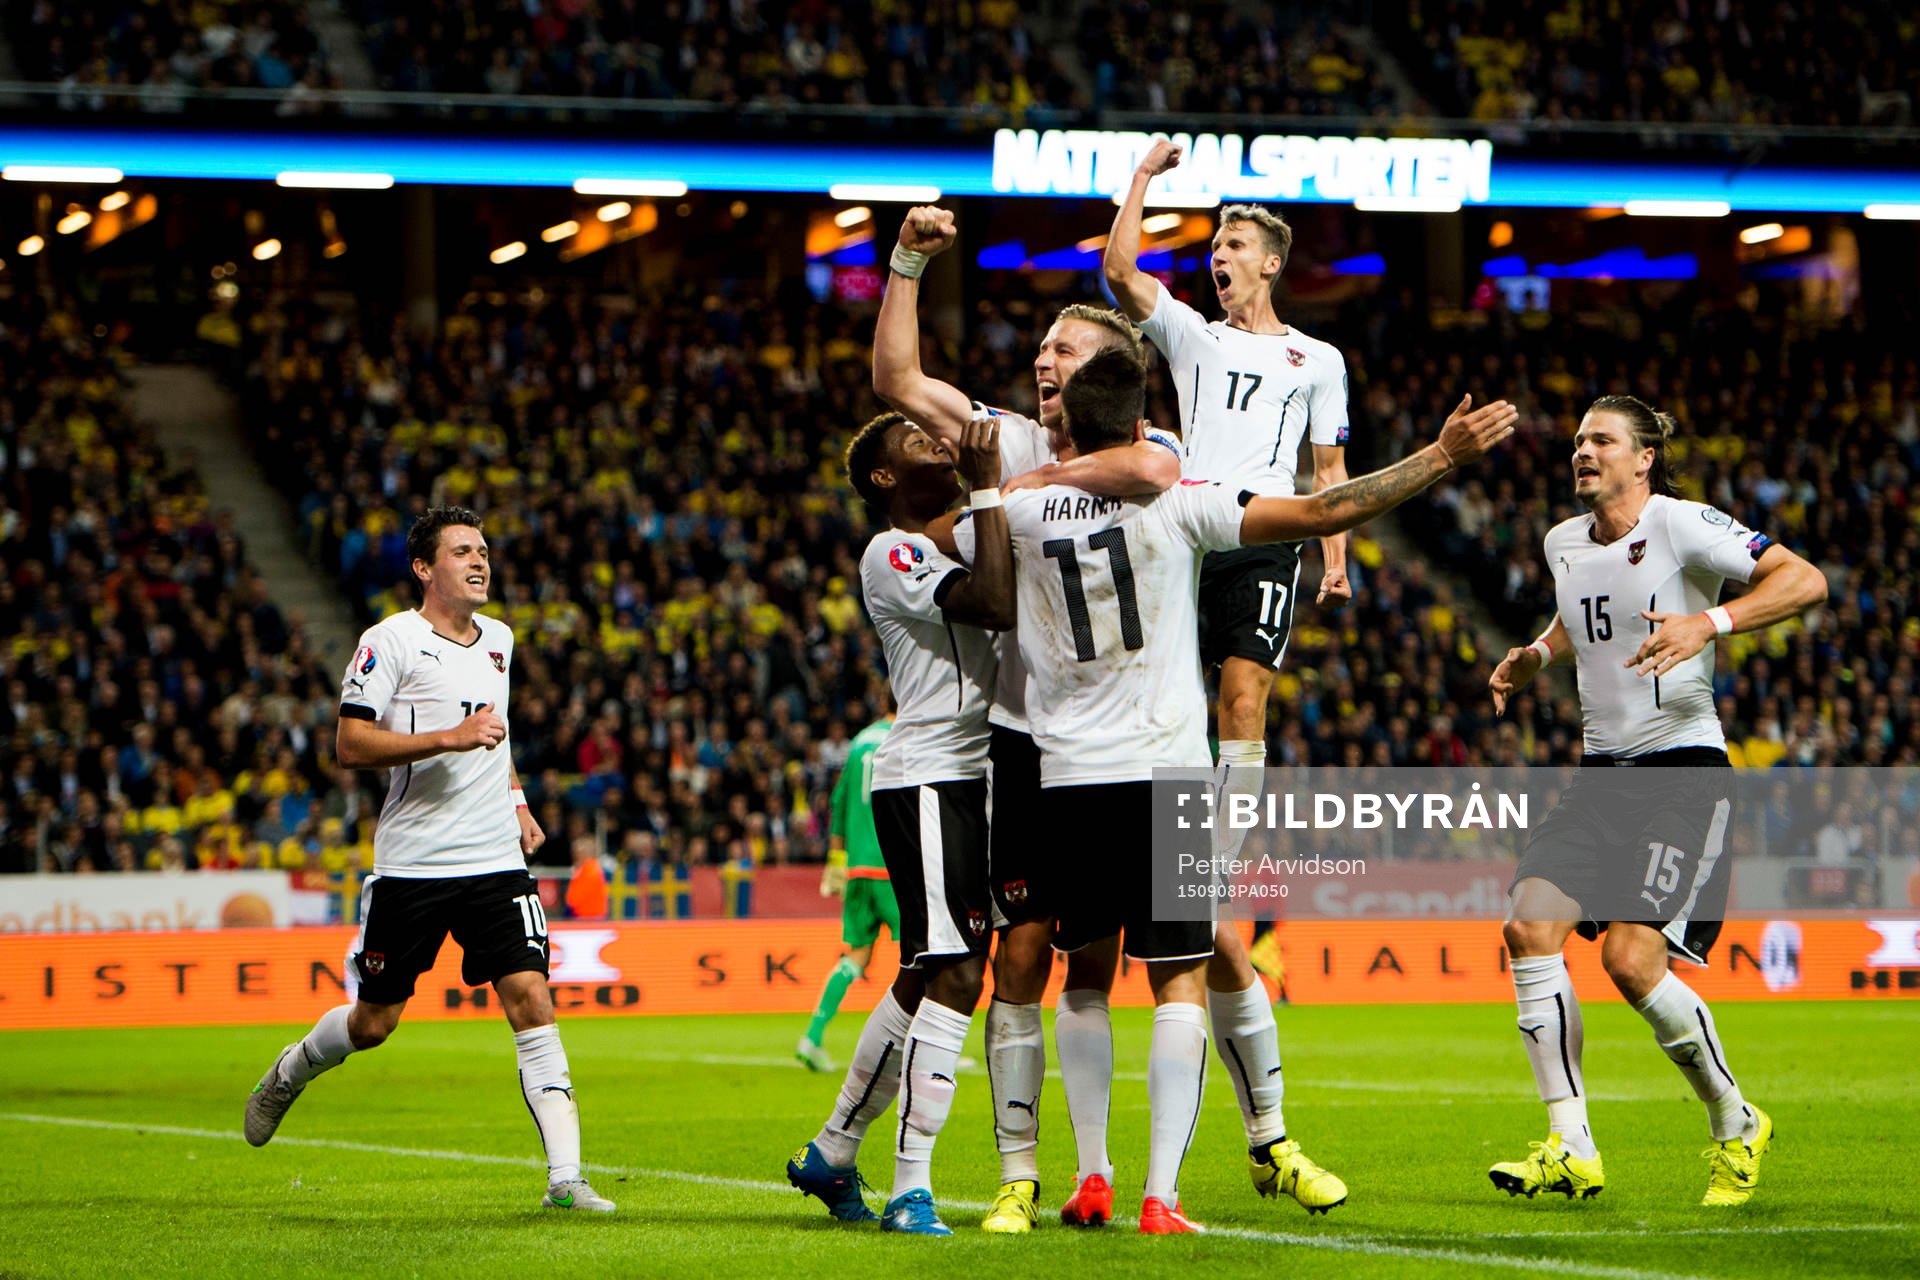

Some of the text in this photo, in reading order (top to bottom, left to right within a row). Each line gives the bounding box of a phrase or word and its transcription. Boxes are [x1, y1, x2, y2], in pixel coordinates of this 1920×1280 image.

[1226, 370, 1263, 412] 17
[1042, 526, 1144, 662] 11
[1258, 580, 1288, 628] 17
[1580, 595, 1613, 644] 15
[1643, 842, 1685, 893] 15
[512, 894, 549, 938] 10
[444, 983, 641, 1009] HCO
